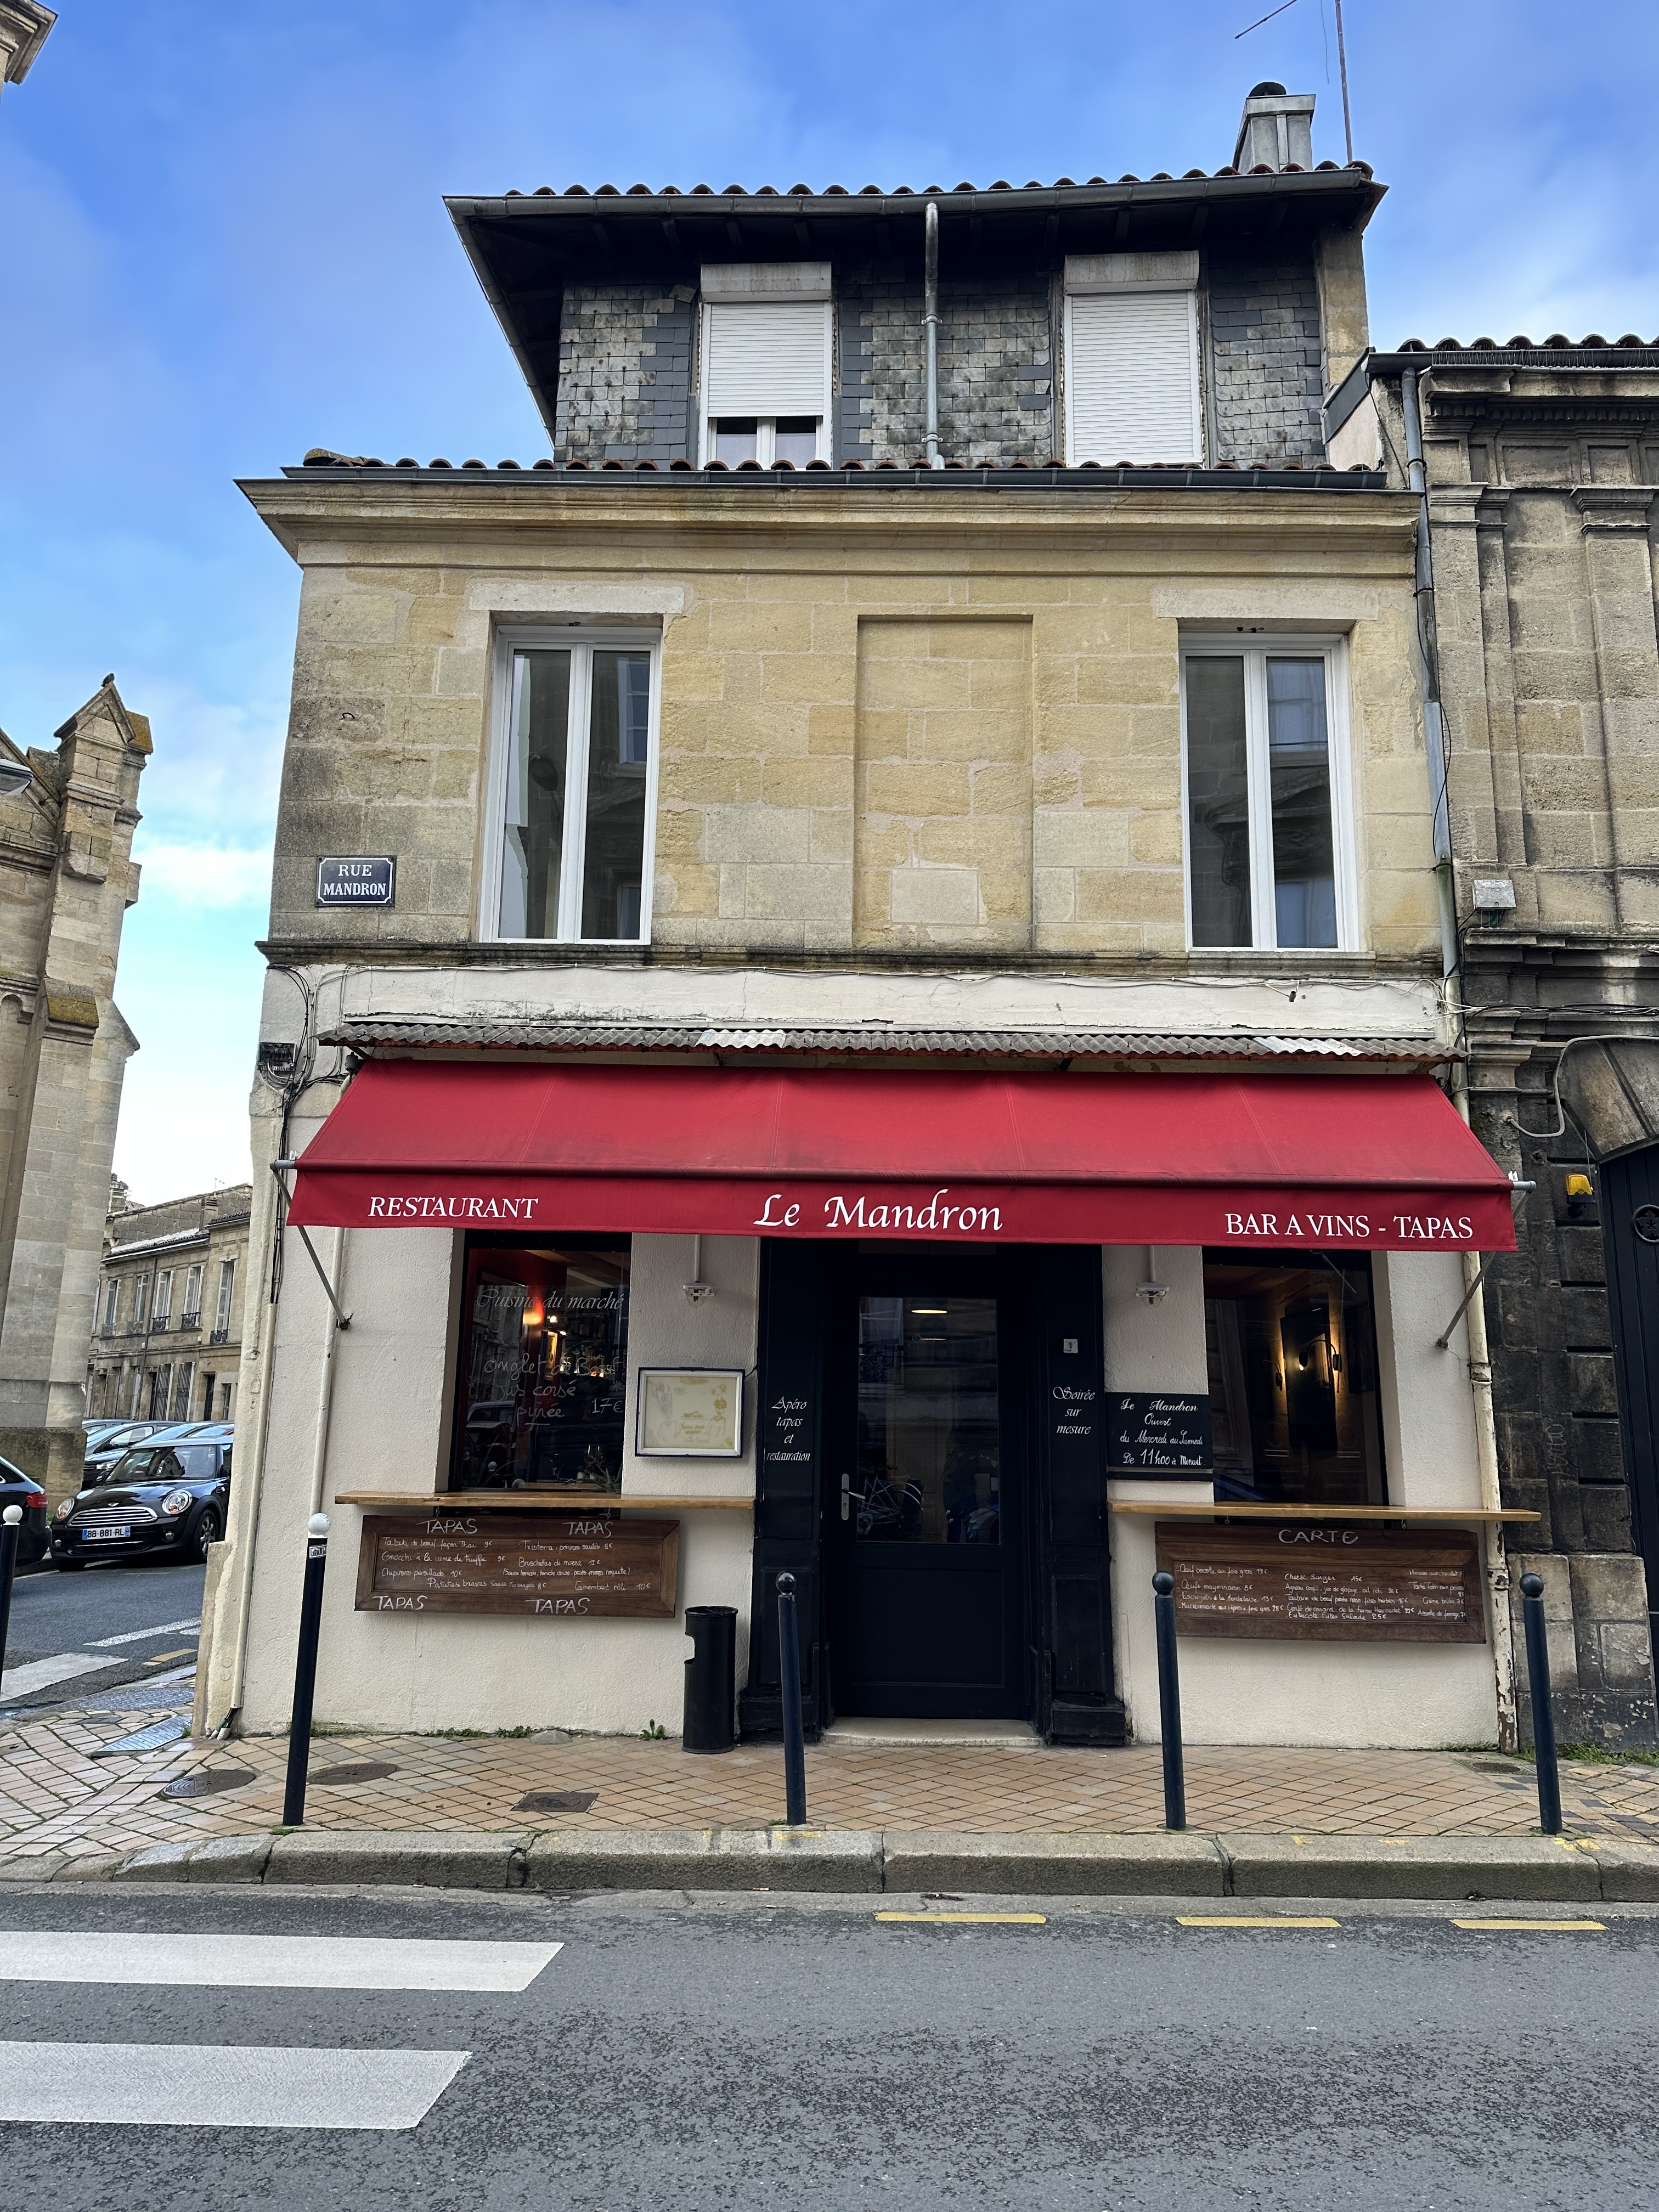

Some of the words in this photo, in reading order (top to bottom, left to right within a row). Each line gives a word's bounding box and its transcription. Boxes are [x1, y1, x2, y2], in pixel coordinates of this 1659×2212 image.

[338, 864, 373, 877] RUE
[323, 883, 387, 895] MANDRON
[367, 1196, 539, 1219] RESTAURANT
[753, 1193, 800, 1227] Le
[824, 1189, 1004, 1231] Mandron
[1224, 1212, 1279, 1235] BAR
[1284, 1214, 1305, 1236] A
[1306, 1215, 1370, 1238] VINS
[1393, 1216, 1474, 1239] TAPAS
[541, 1290, 565, 1308] du
[567, 1291, 624, 1310] marché
[1052, 1386, 1096, 1401] Soirée
[771, 1396, 808, 1414] Apéro
[1149, 1399, 1199, 1412] Mandron
[1064, 1409, 1082, 1417] sur
[1144, 1413, 1172, 1426] Ouvert
[776, 1417, 803, 1431] tapas
[1056, 1425, 1092, 1435] mesure
[783, 1434, 794, 1443] et
[1120, 1430, 1130, 1443] du
[1135, 1429, 1167, 1445] Mercredi
[1178, 1429, 1204, 1445] Samedi
[766, 1450, 811, 1462] restauration
[1122, 1452, 1135, 1465] De
[1139, 1448, 1170, 1465] 11h00
[1171, 1456, 1177, 1465] à
[415, 1518, 478, 1534] TAPAS
[562, 1521, 613, 1538] TAPAS
[1278, 1529, 1359, 1544] CARTE
[424, 1552, 432, 1562] la
[454, 1553, 463, 1562] de
[427, 1577, 460, 1588] Patatas
[574, 1581, 610, 1590] Camembert
[372, 1595, 428, 1611] TAPAS
[525, 1597, 590, 1615] TAPAS
[1341, 1612, 1367, 1621] Salade
